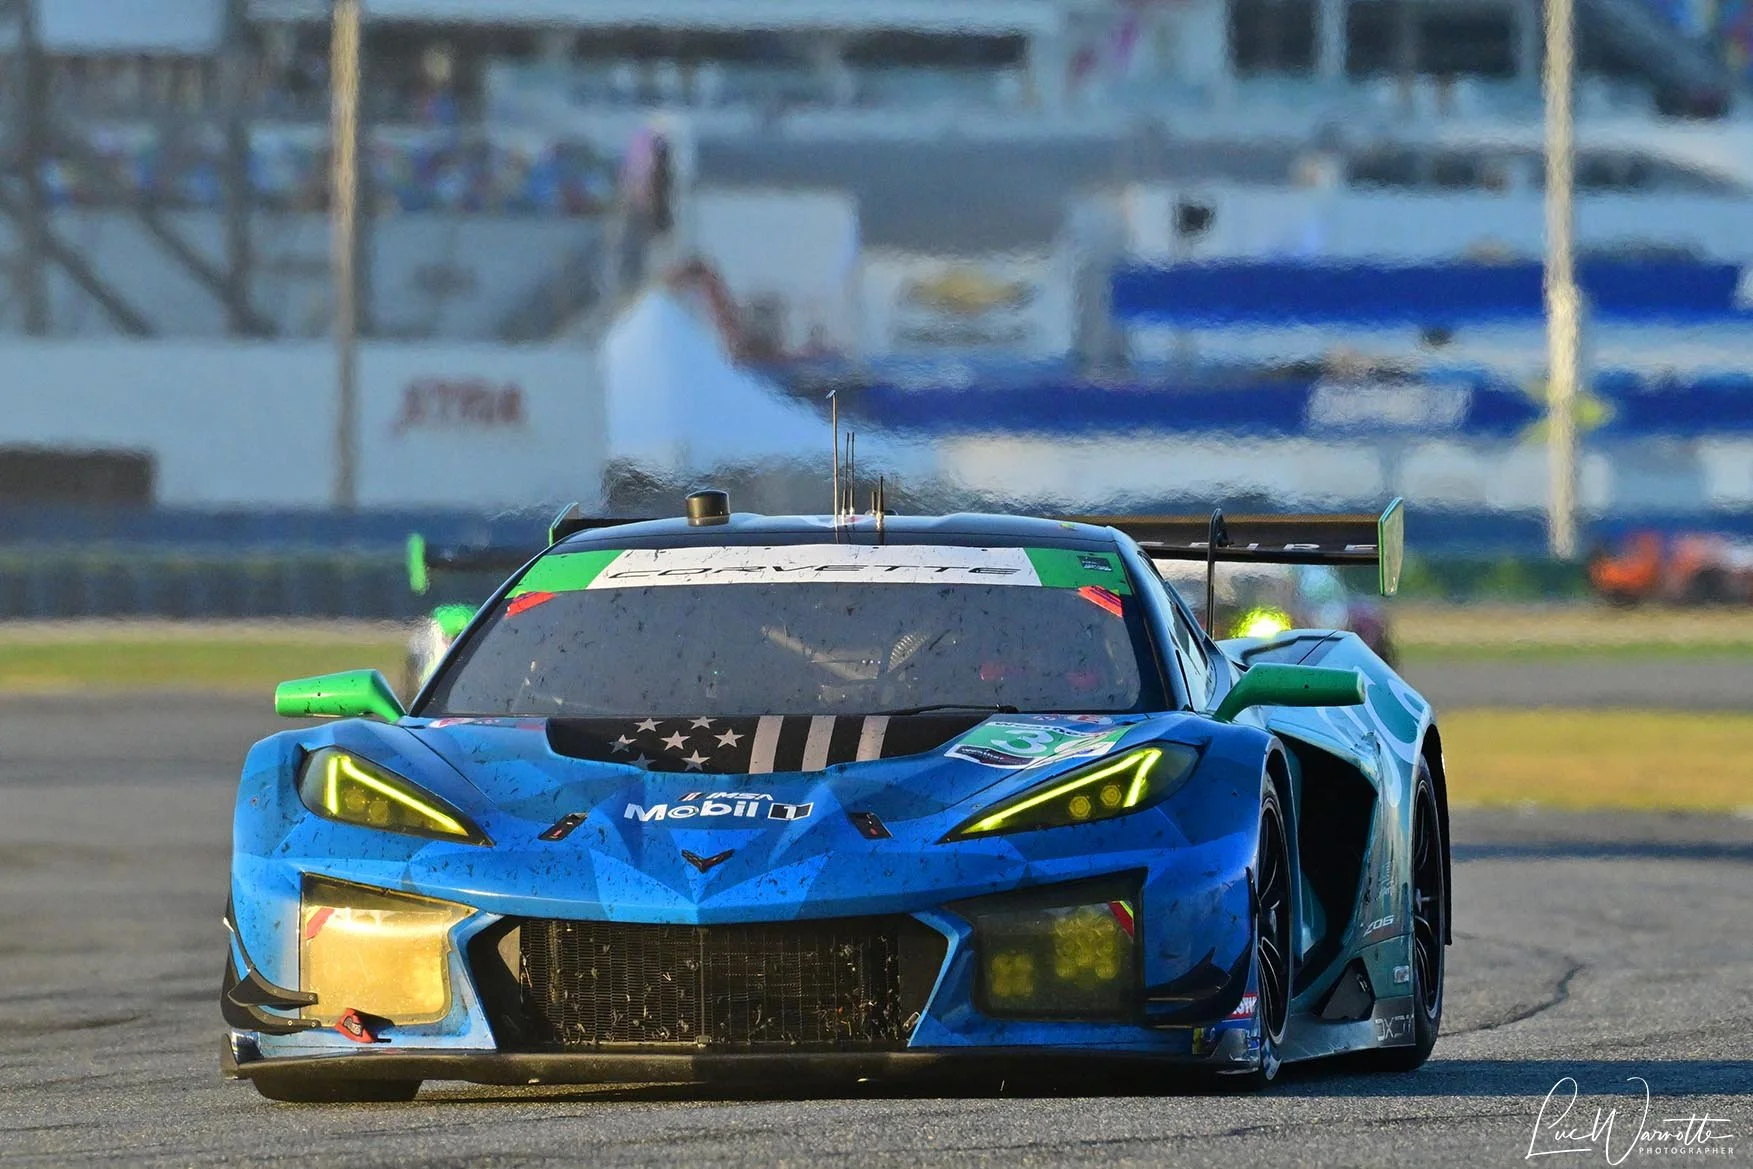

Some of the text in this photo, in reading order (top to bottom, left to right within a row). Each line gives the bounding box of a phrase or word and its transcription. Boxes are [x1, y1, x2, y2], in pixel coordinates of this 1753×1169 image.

[608, 565, 1021, 579] CORVETTE
[707, 792, 774, 800] IMSA
[624, 801, 759, 822] Mobil
